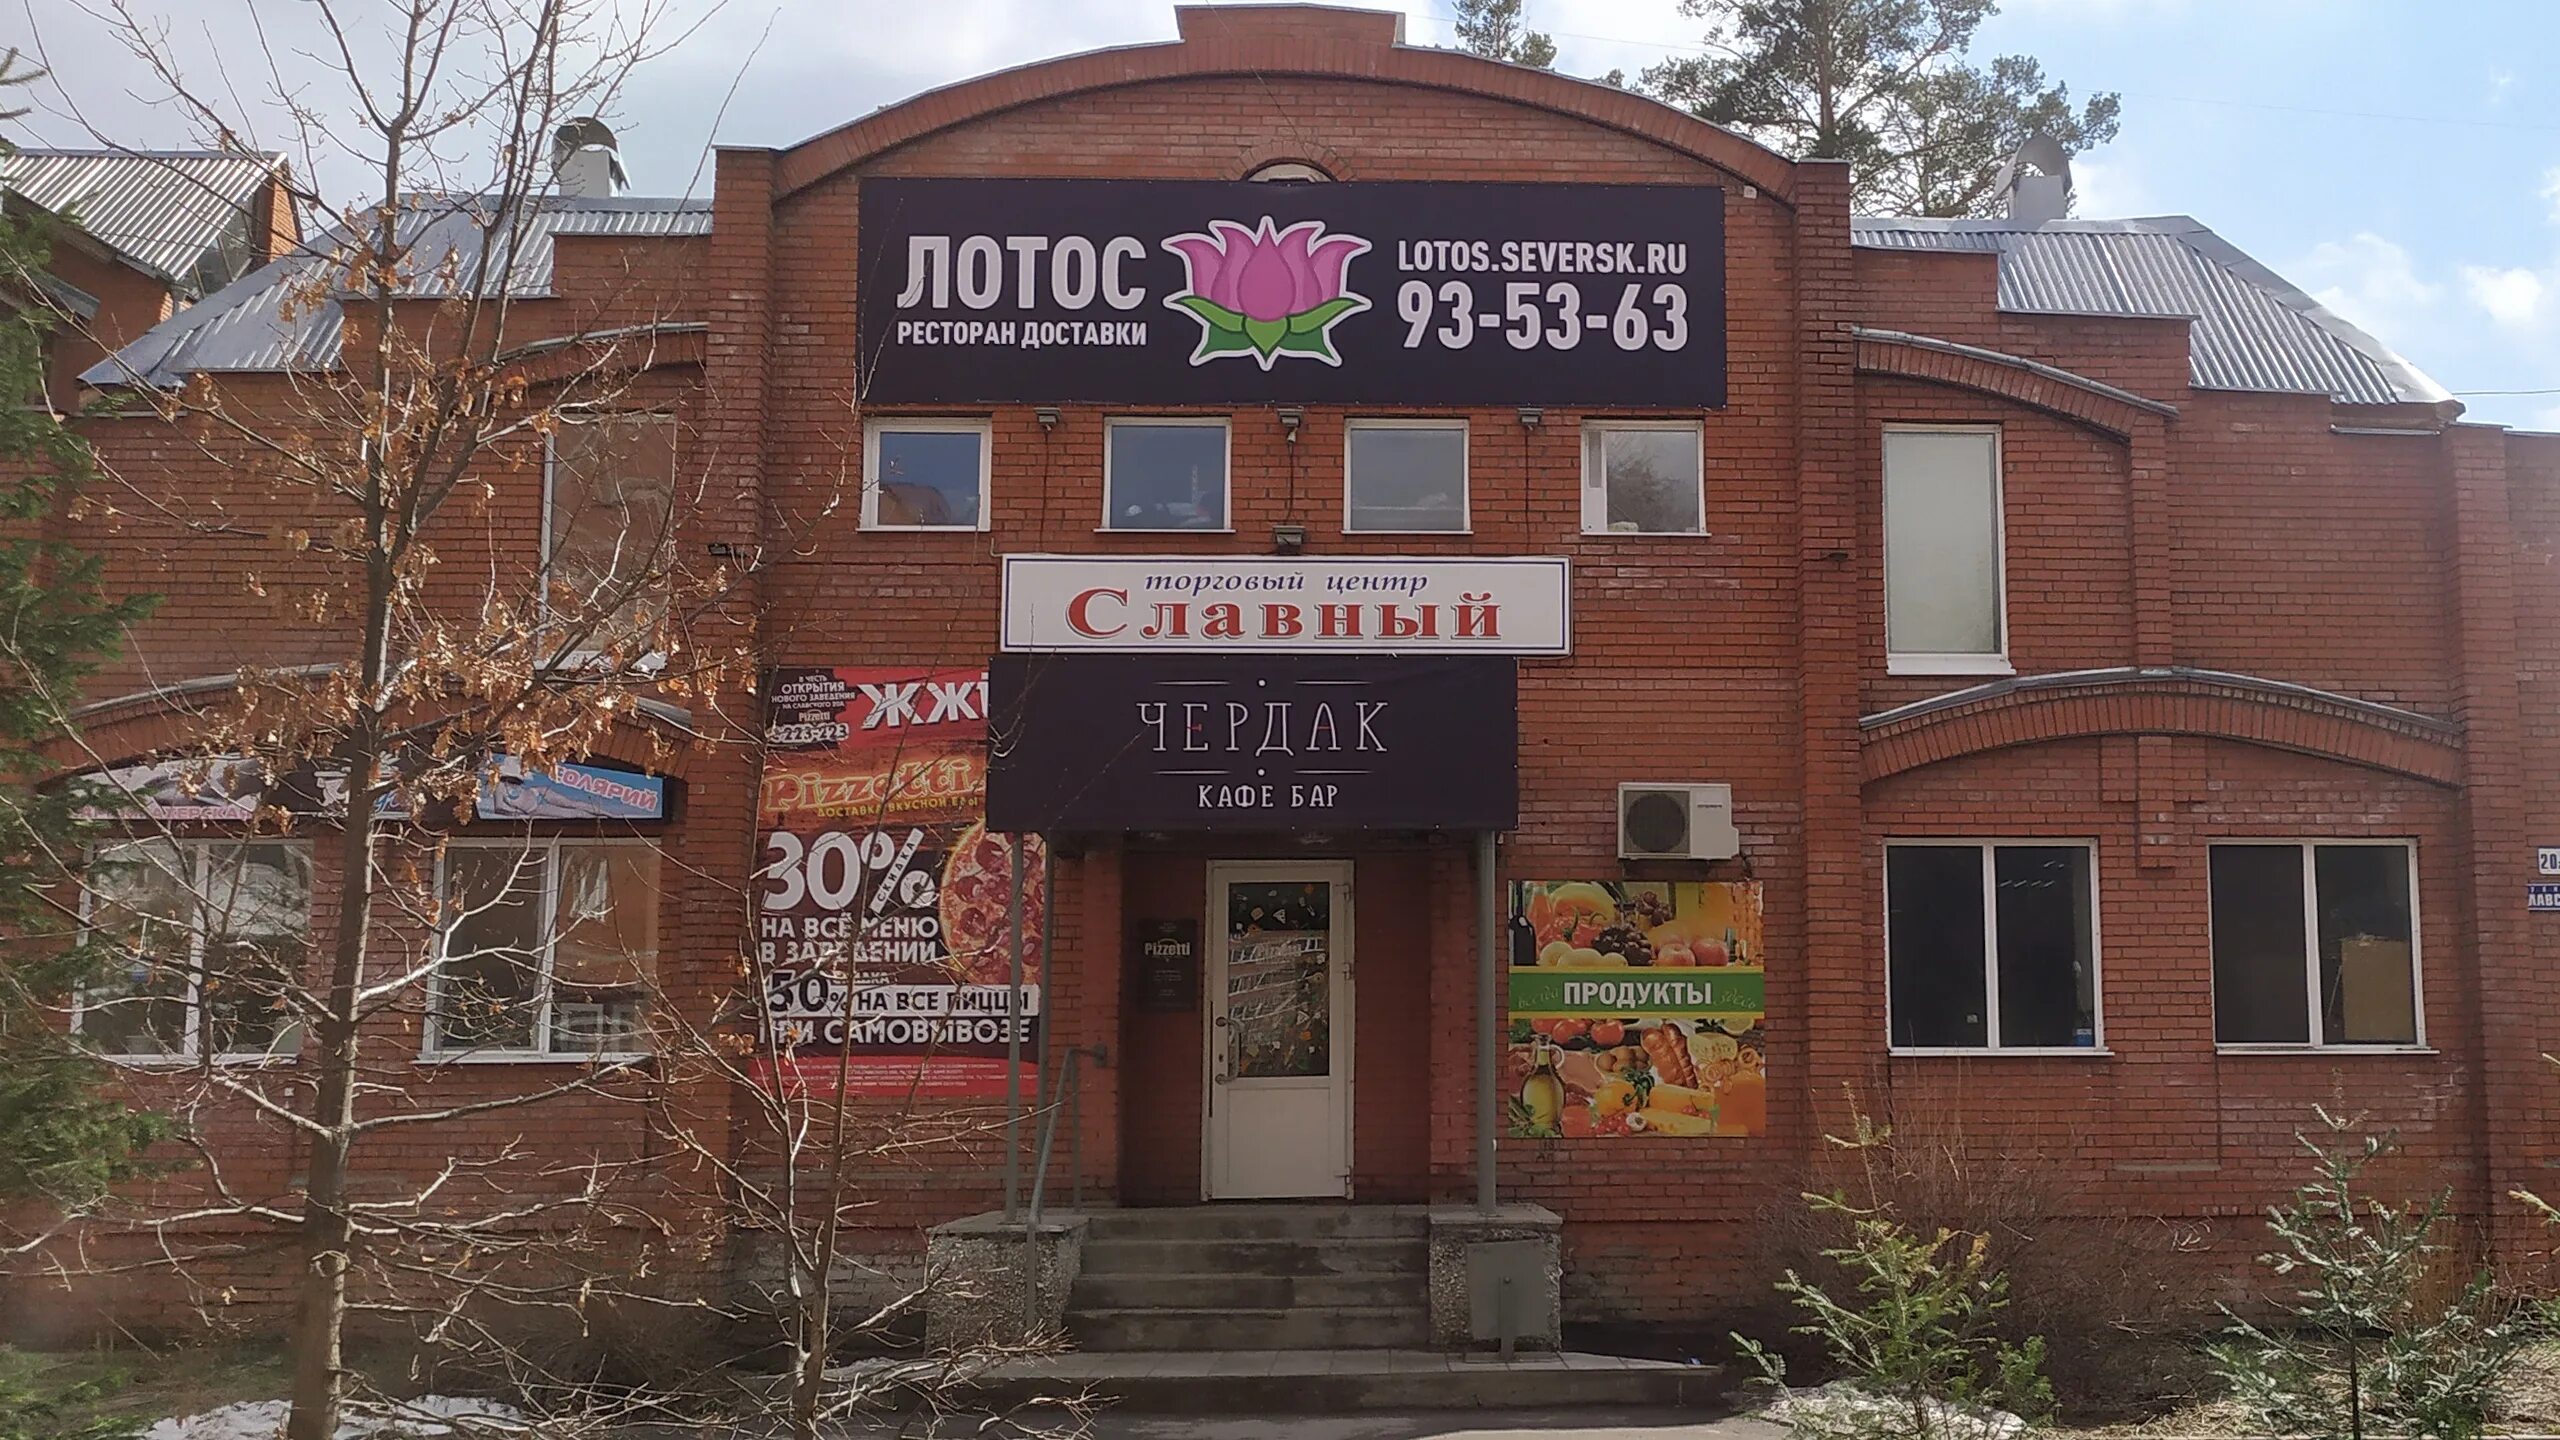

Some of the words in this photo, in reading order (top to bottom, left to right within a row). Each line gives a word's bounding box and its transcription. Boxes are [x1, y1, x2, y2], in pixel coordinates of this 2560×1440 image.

[1397, 240, 1687, 274] LOTOS.SEVERSK.RU
[896, 235, 1147, 310] ЛОТОС
[1397, 279, 1688, 351] 93-53-63
[897, 321, 1016, 345] РЕСТОРАН
[1020, 321, 1147, 349] ДОСТАВКИ
[1144, 571, 1305, 596] торговый
[1325, 573, 1429, 597] центр
[1065, 587, 1502, 640] Славный
[781, 681, 845, 695] ОТКРЫТИЯ
[805, 675, 828, 683] ЧЕСТЬ
[771, 694, 807, 704] НОВОГО
[809, 692, 856, 702] ЗАВЕДЕНИЯ
[1136, 702, 1389, 757] ЧЕРДАК
[1198, 785, 1274, 808] КАФЕ
[1290, 785, 1339, 808] БАР
[761, 831, 936, 911] 30%
[875, 842, 916, 903] СКИДКА
[2540, 853, 2560, 870] 20
[761, 917, 795, 938] НА
[861, 916, 939, 938] МЕНЮ
[761, 942, 776, 964] В
[858, 992, 888, 1011] НА
[896, 991, 938, 1011] ВСЕ
[1562, 982, 1713, 1009] ПРОДУКТЫ
